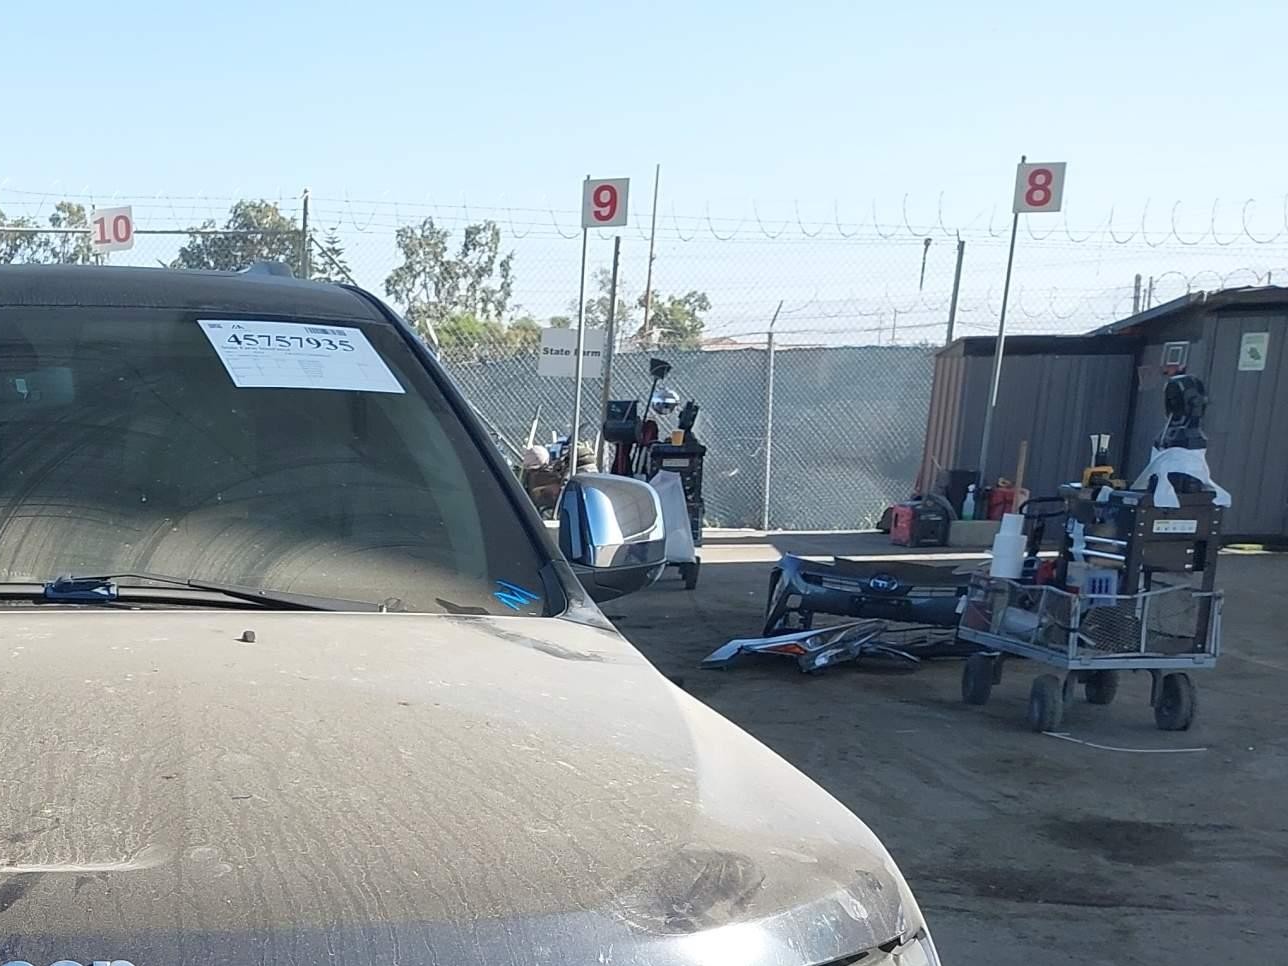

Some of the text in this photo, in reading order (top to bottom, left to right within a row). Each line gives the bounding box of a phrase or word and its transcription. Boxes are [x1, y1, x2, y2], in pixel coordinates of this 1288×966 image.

[1025, 168, 1053, 207] 8
[593, 184, 617, 222] 9
[93, 215, 131, 244] 10
[227, 333, 355, 352] 45757935
[542, 346, 571, 356] State
